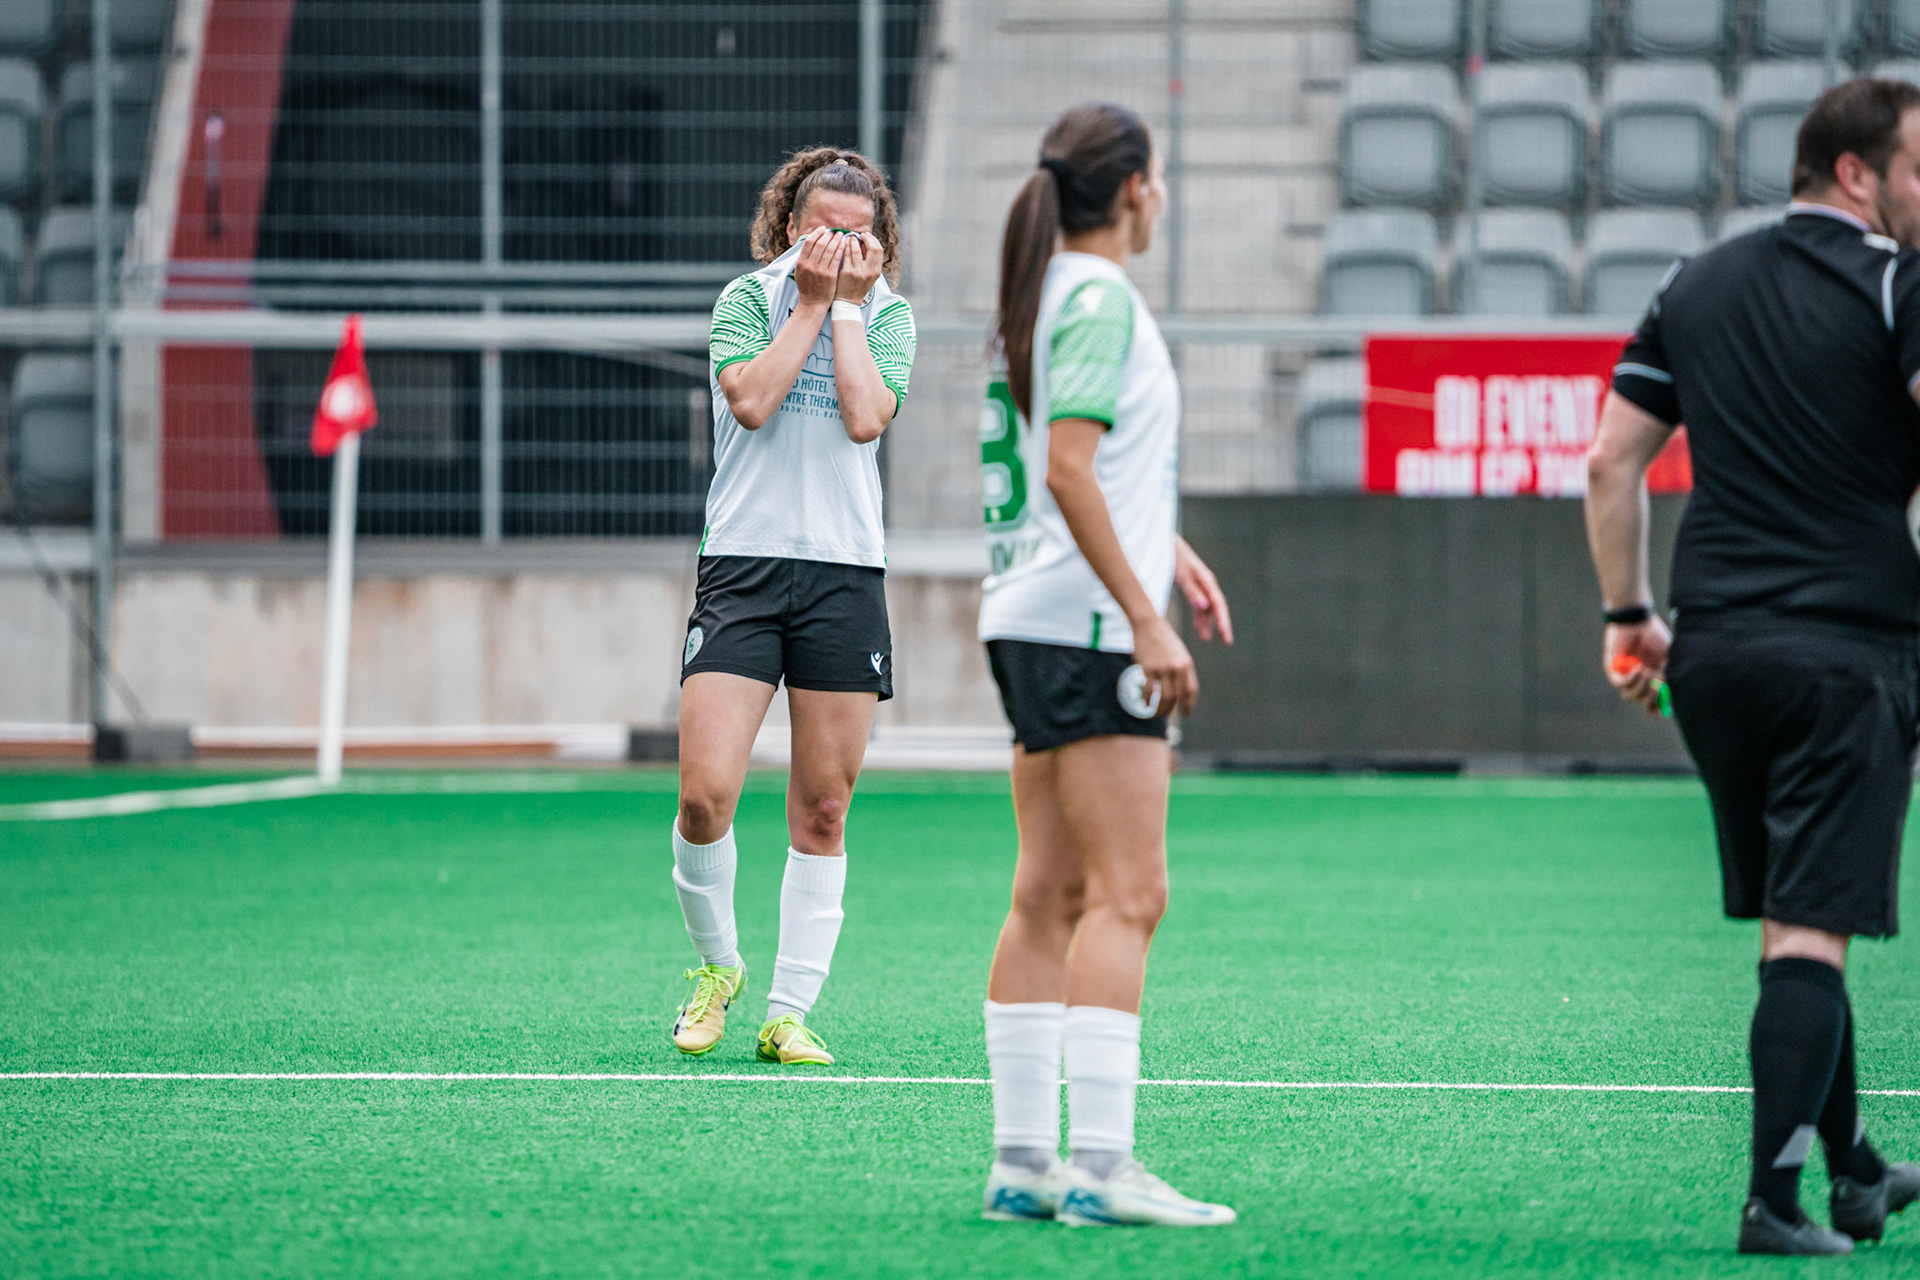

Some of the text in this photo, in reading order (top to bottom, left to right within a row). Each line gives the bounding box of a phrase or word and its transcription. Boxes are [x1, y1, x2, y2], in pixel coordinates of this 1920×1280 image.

[800, 376, 828, 393] HÔTEL
[785, 391, 839, 411] NTRE THERM
